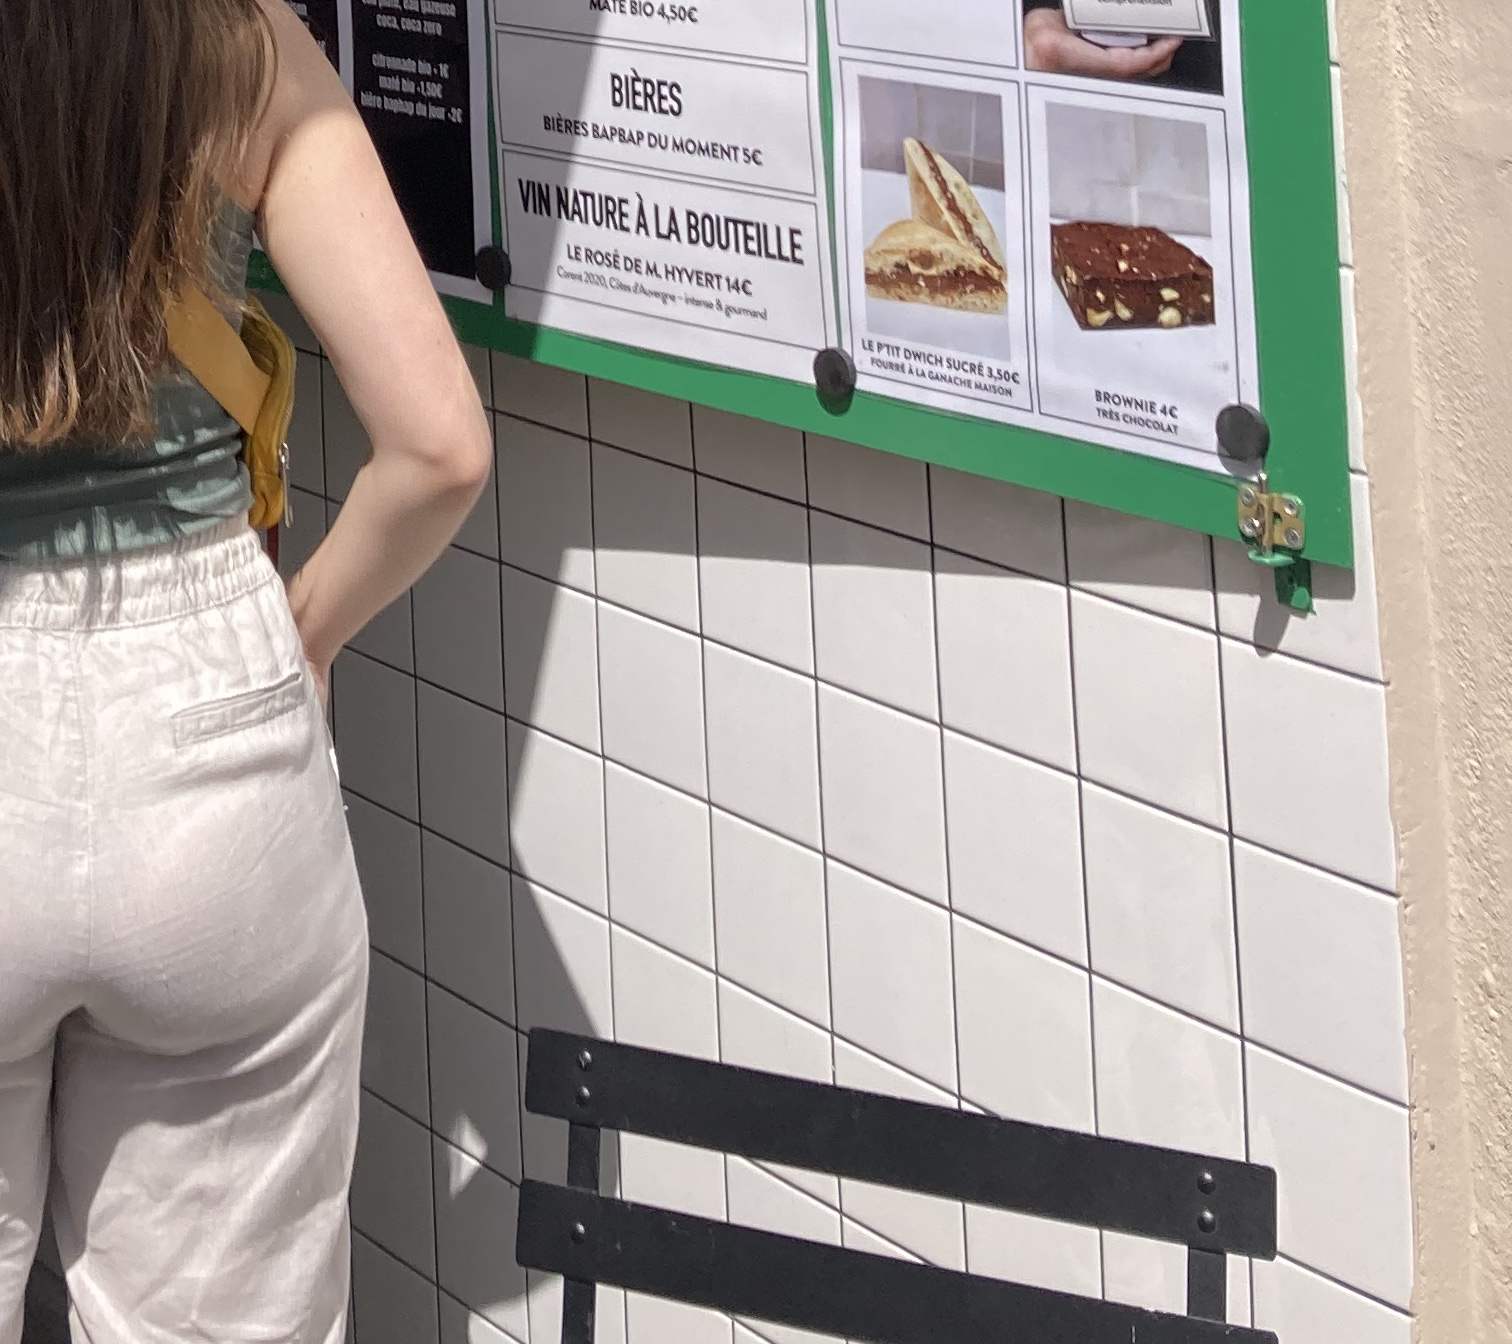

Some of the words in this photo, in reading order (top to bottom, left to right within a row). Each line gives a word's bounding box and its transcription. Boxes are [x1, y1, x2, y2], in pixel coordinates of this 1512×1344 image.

[629, 0, 654, 17] BIO
[657, 2, 698, 24] 4,50€
[610, 68, 683, 117] BIÈRES
[543, 112, 588, 138] BIÈRES
[591, 122, 645, 147] BAPBAP
[647, 131, 669, 150] DU
[671, 136, 739, 161] MOMENT
[743, 148, 763, 166] 5€
[518, 177, 552, 218] VIN
[556, 183, 630, 233] NATURE
[635, 191, 650, 239] À
[654, 202, 681, 244] LA
[686, 208, 804, 266] BOUTEILLE
[567, 243, 582, 262] LE
[584, 246, 621, 270] ROSÉ
[624, 256, 643, 275] DE
[645, 261, 661, 278] M.
[664, 263, 722, 290] HYVERT
[725, 275, 753, 296] 14€
[862, 338, 874, 352] LE
[877, 341, 901, 358] P'TIT
[904, 347, 943, 368] DWICH
[946, 357, 984, 377] SUCRÉ
[986, 366, 1020, 384] 3,50€
[871, 357, 905, 374] FOURRÉ
[908, 363, 914, 375] À
[916, 367, 926, 378] LA
[928, 370, 972, 389] GANACHE
[974, 381, 1012, 399] MAISON
[1095, 389, 1157, 414] BROWNIE
[1160, 404, 1178, 419] 4€
[1096, 407, 1120, 421] TRÈS
[1122, 413, 1178, 435] CHOCOLAT
